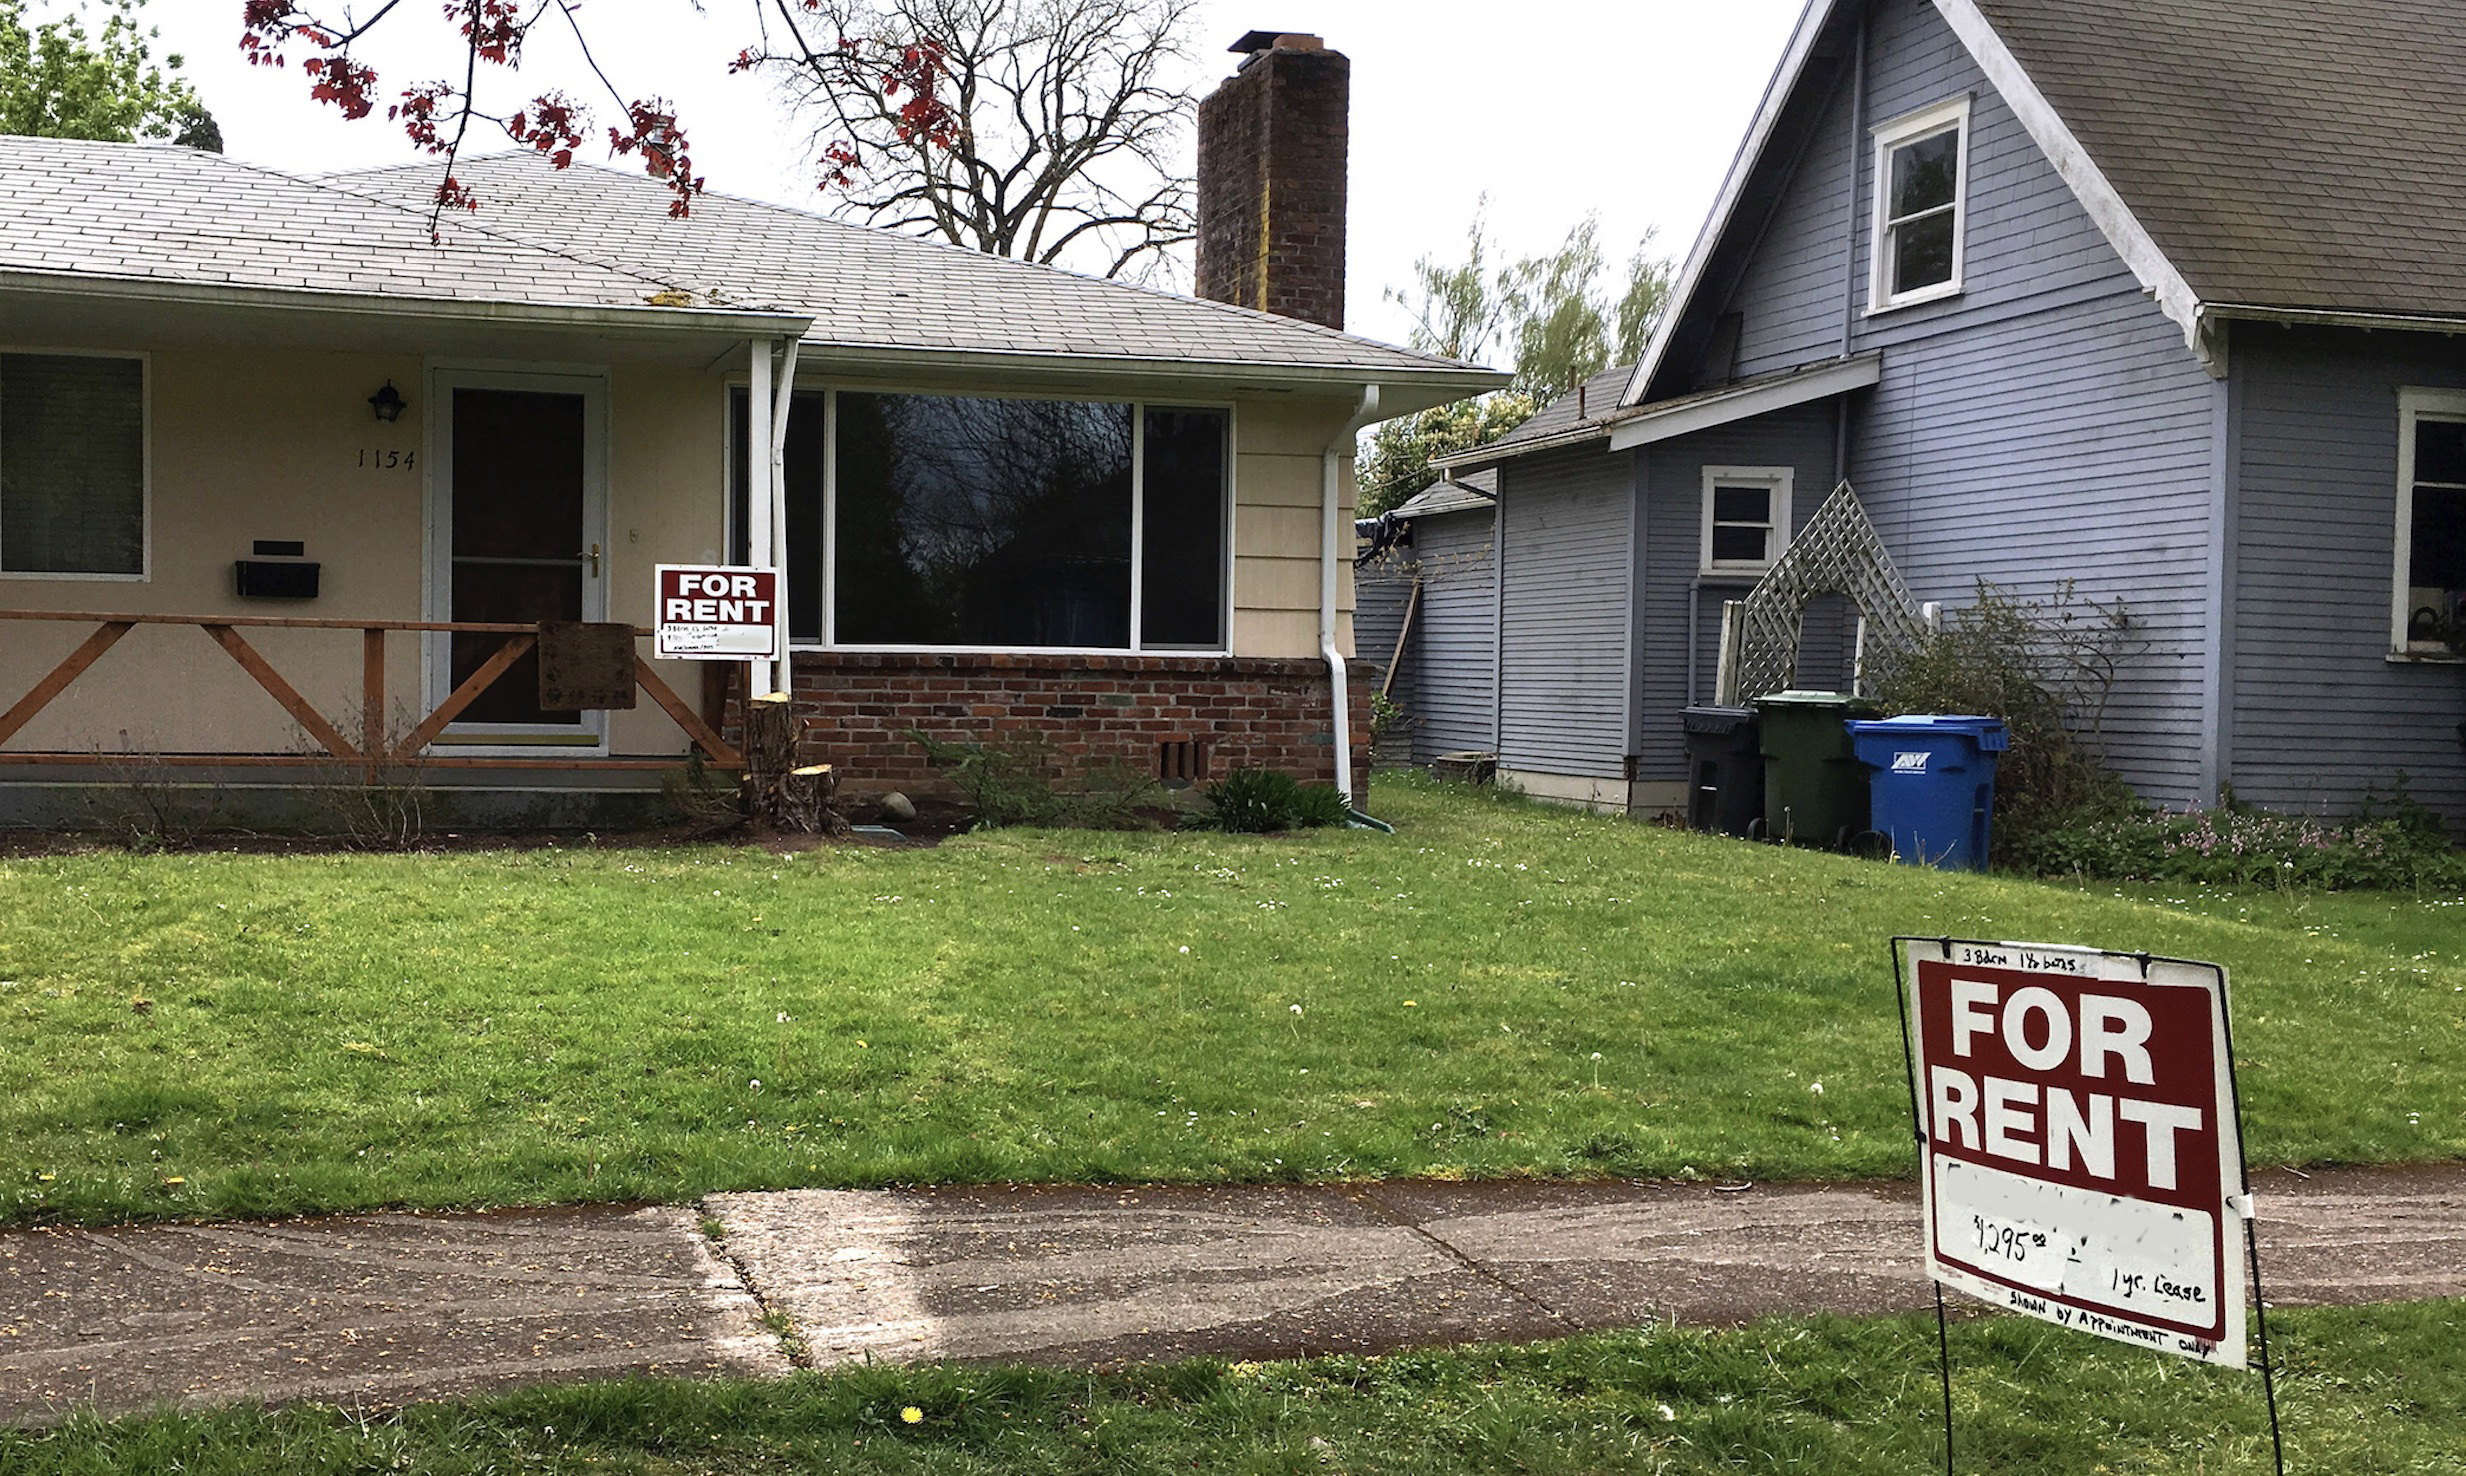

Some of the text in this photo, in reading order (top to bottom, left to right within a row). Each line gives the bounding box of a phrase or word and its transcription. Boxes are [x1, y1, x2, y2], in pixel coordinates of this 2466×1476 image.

[358, 449, 415, 471] 1154
[679, 574, 757, 598] FOR
[666, 598, 770, 622] RENT
[1964, 949, 1970, 962] 3
[1950, 979, 2156, 1085] FOR
[1931, 1065, 2202, 1191] RENT
[2112, 1268, 2206, 1302] 1 yr. Lease
[2178, 1339, 2211, 1359] ONLY
